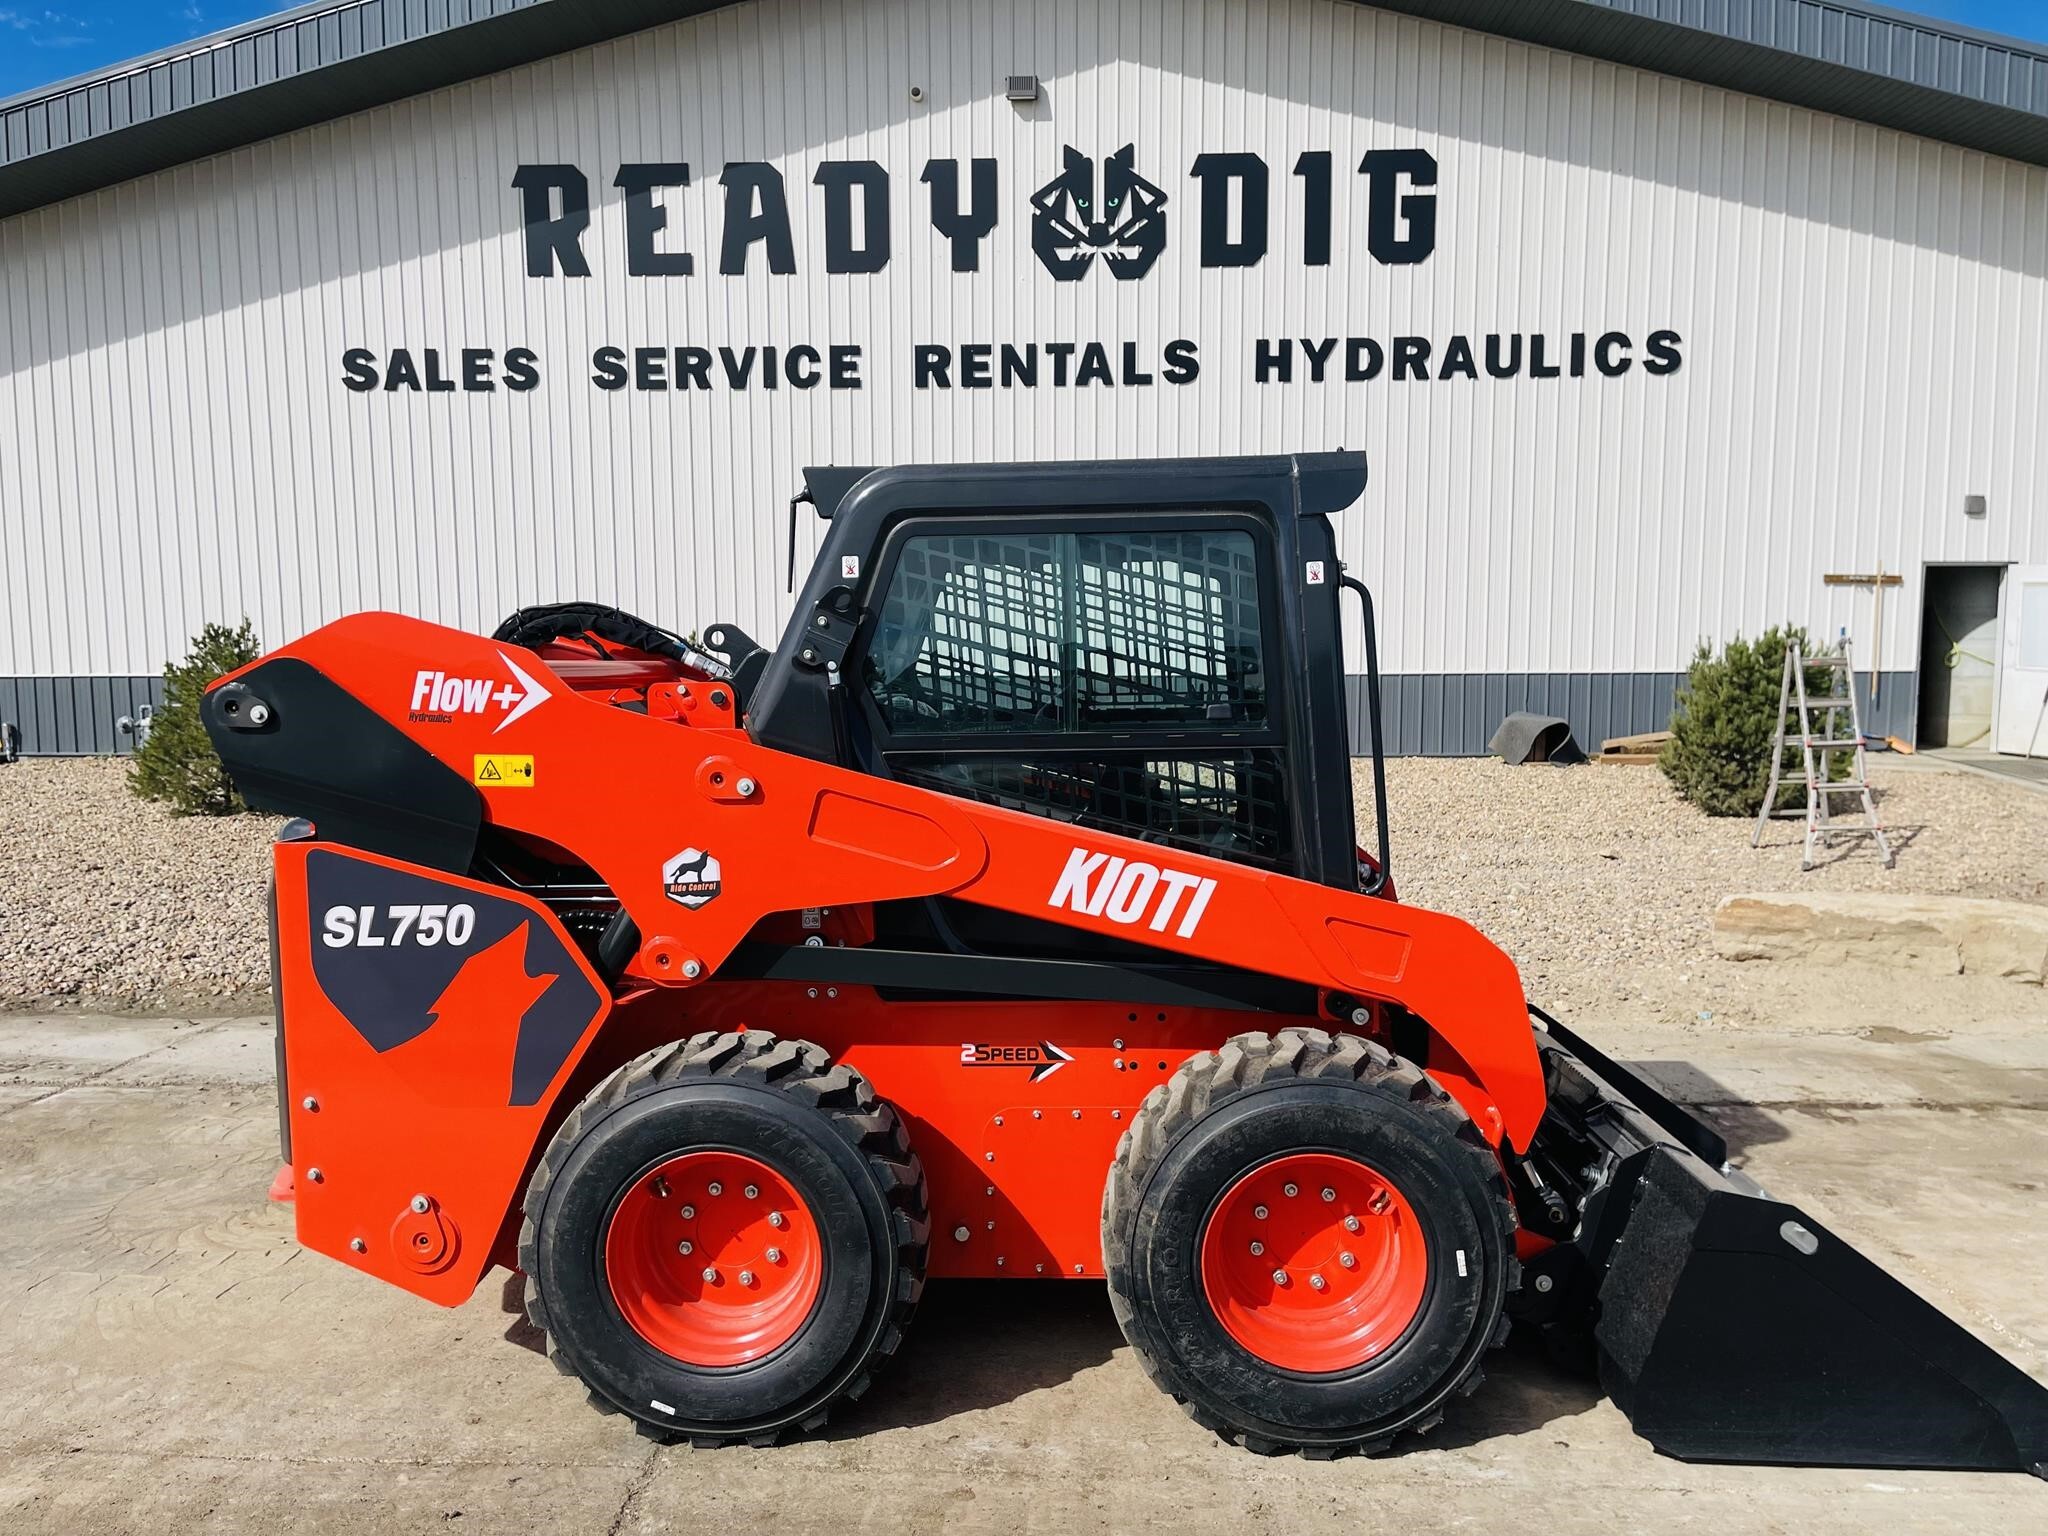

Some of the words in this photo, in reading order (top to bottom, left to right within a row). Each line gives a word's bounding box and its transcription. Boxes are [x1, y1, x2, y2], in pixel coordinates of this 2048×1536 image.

[511, 158, 997, 277] READY
[341, 347, 539, 392] SALES
[591, 344, 863, 391] SERVICE
[915, 339, 1200, 389] RENTALS
[1256, 330, 1682, 383] HYDRAULICS
[408, 712, 453, 724] Hydraulics
[669, 884, 687, 893] Ride
[688, 881, 717, 892] Control
[1047, 847, 1218, 939] KIOTI
[322, 903, 476, 948] SL750
